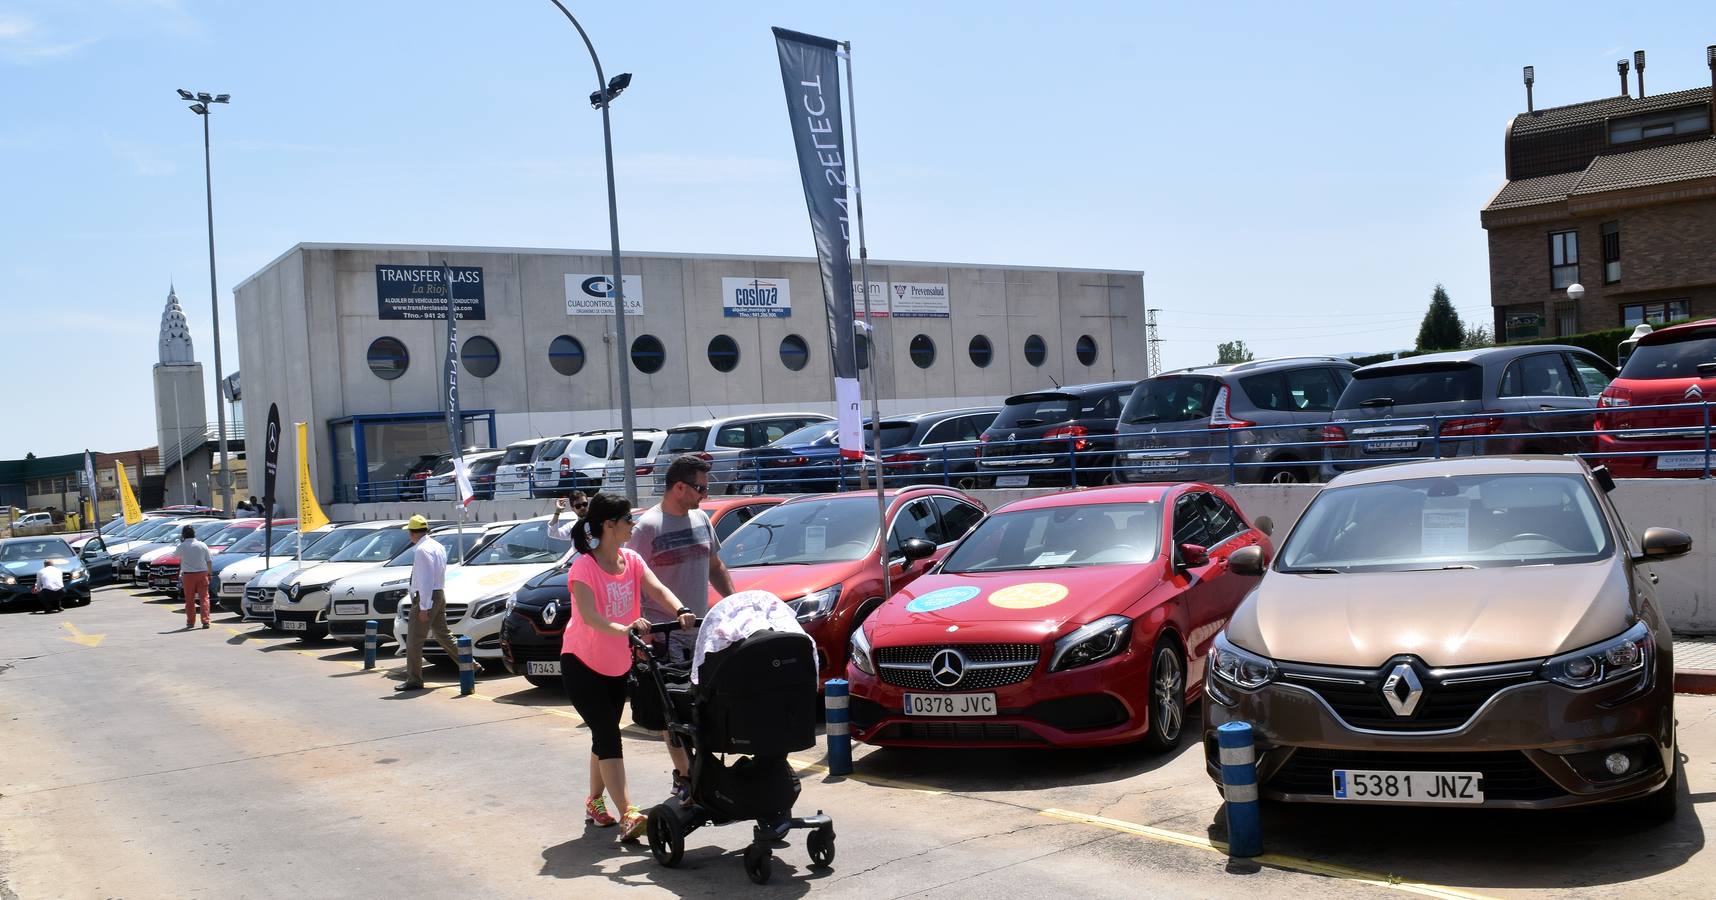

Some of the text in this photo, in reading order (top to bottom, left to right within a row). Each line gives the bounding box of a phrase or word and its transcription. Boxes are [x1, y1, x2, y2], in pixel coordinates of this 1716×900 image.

[380, 269, 441, 282] TRANSFER
[735, 282, 778, 306] costoza
[911, 285, 945, 296] Prevensalud
[533, 663, 555, 674] 7343
[914, 697, 992, 713] 0378 JVC
[1353, 774, 1474, 799] 5381 JNZ
